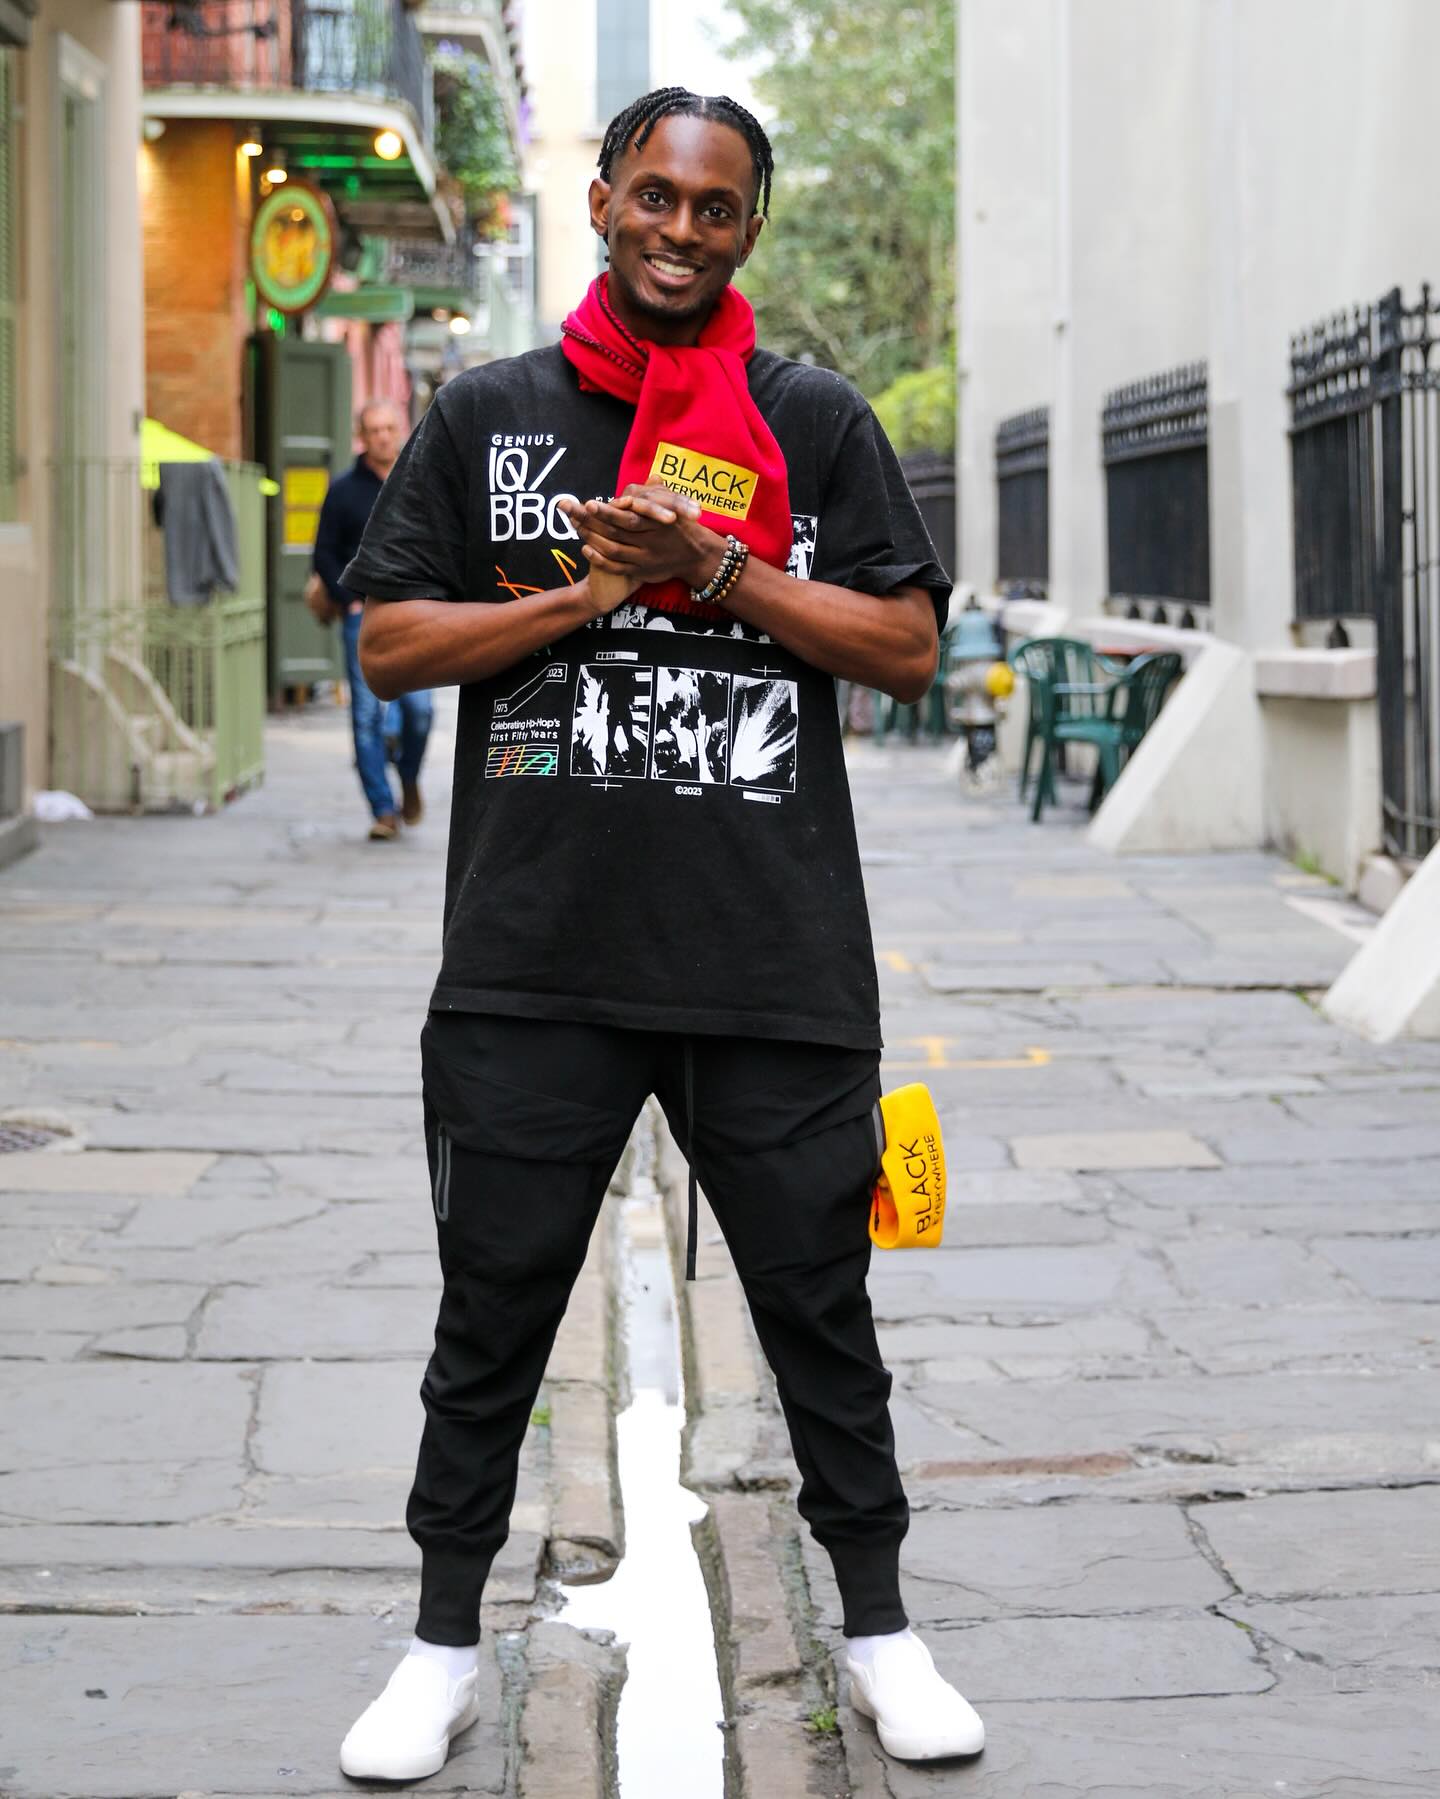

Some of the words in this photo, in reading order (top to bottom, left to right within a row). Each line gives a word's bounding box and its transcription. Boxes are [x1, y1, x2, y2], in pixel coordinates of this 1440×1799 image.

[491, 434, 555, 447] GENIUS
[660, 453, 750, 499] BLACK
[663, 479, 747, 512] VERYWHERE®
[489, 493, 581, 542] BBQ
[546, 668, 563, 678] 023
[489, 732, 508, 742] First
[530, 729, 558, 739] Years
[490, 720, 525, 731] Celebrating
[526, 717, 561, 729] Hp-Hop's
[898, 1138, 931, 1235] BLACK
